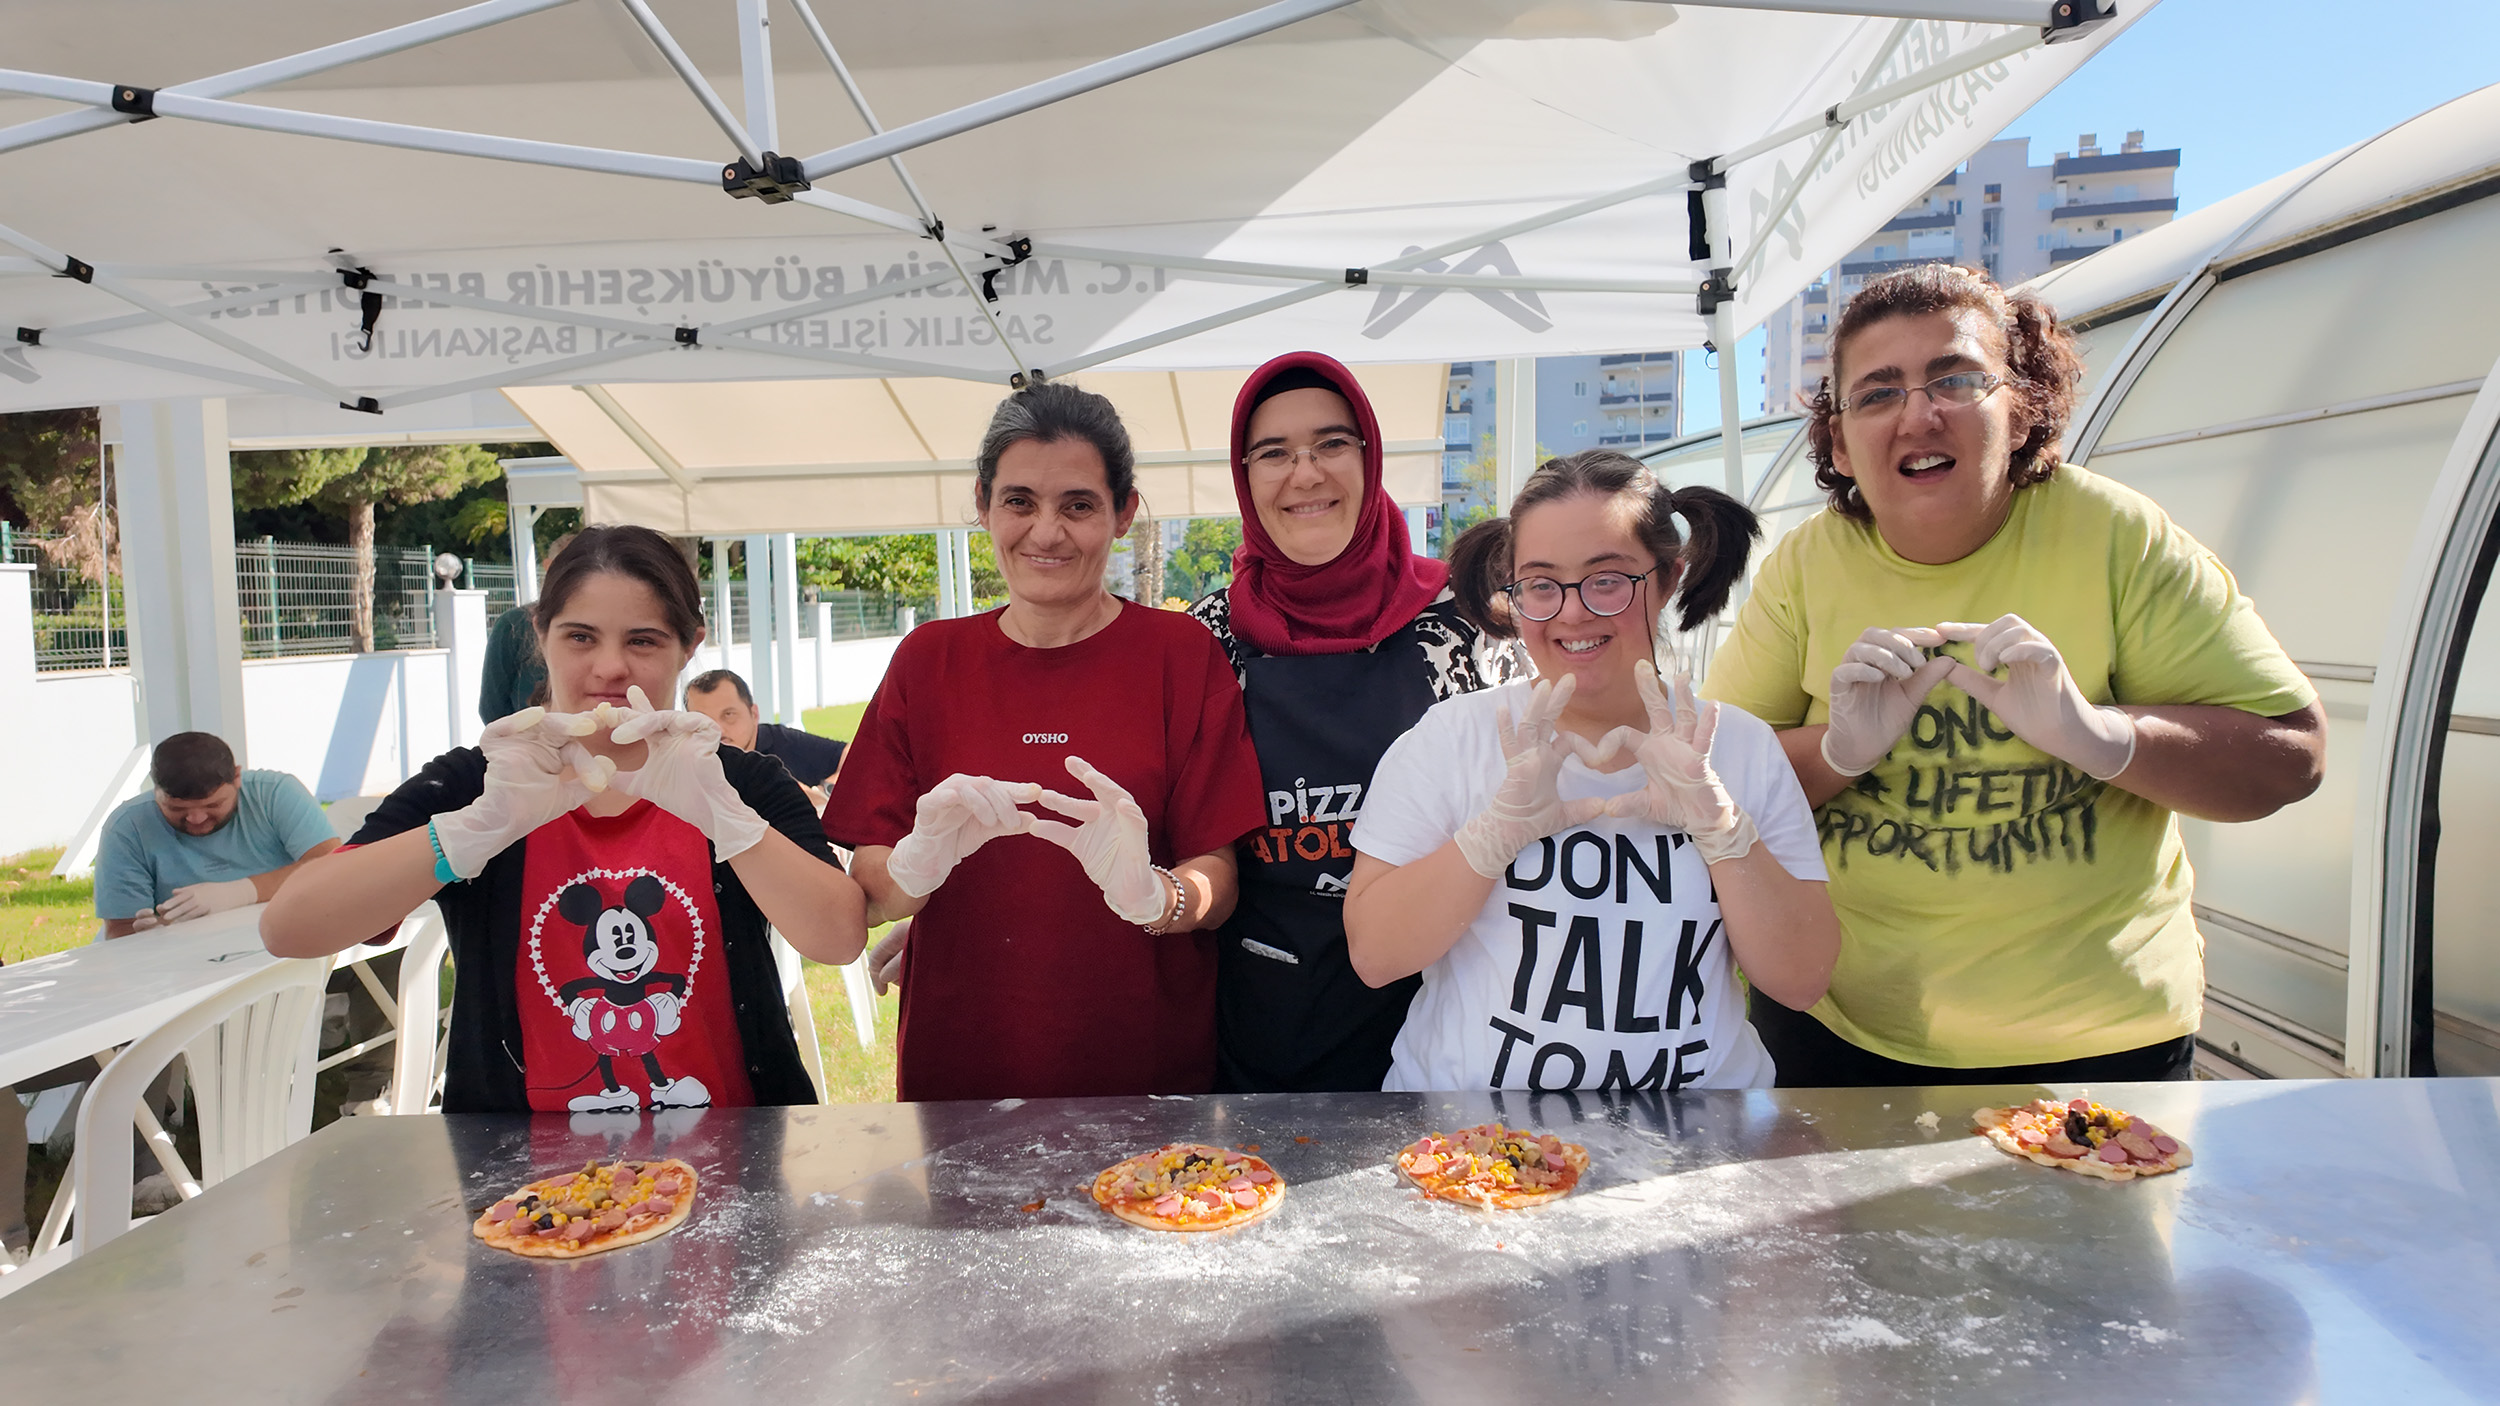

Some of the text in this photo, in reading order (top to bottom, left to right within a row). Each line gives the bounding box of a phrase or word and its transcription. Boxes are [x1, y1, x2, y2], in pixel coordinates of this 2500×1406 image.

[1022, 733, 1069, 744] OYSHO
[1911, 696, 2014, 757] ONC
[1268, 777, 1362, 825] PİZZ
[1906, 762, 2099, 818] LIFETIM
[1249, 822, 1355, 863] ATOL
[1816, 800, 2097, 872] PPORTUNIT
[1505, 830, 1719, 904] DON'
[1507, 902, 1723, 1033] TALK
[1489, 1016, 1710, 1090] TO ME
